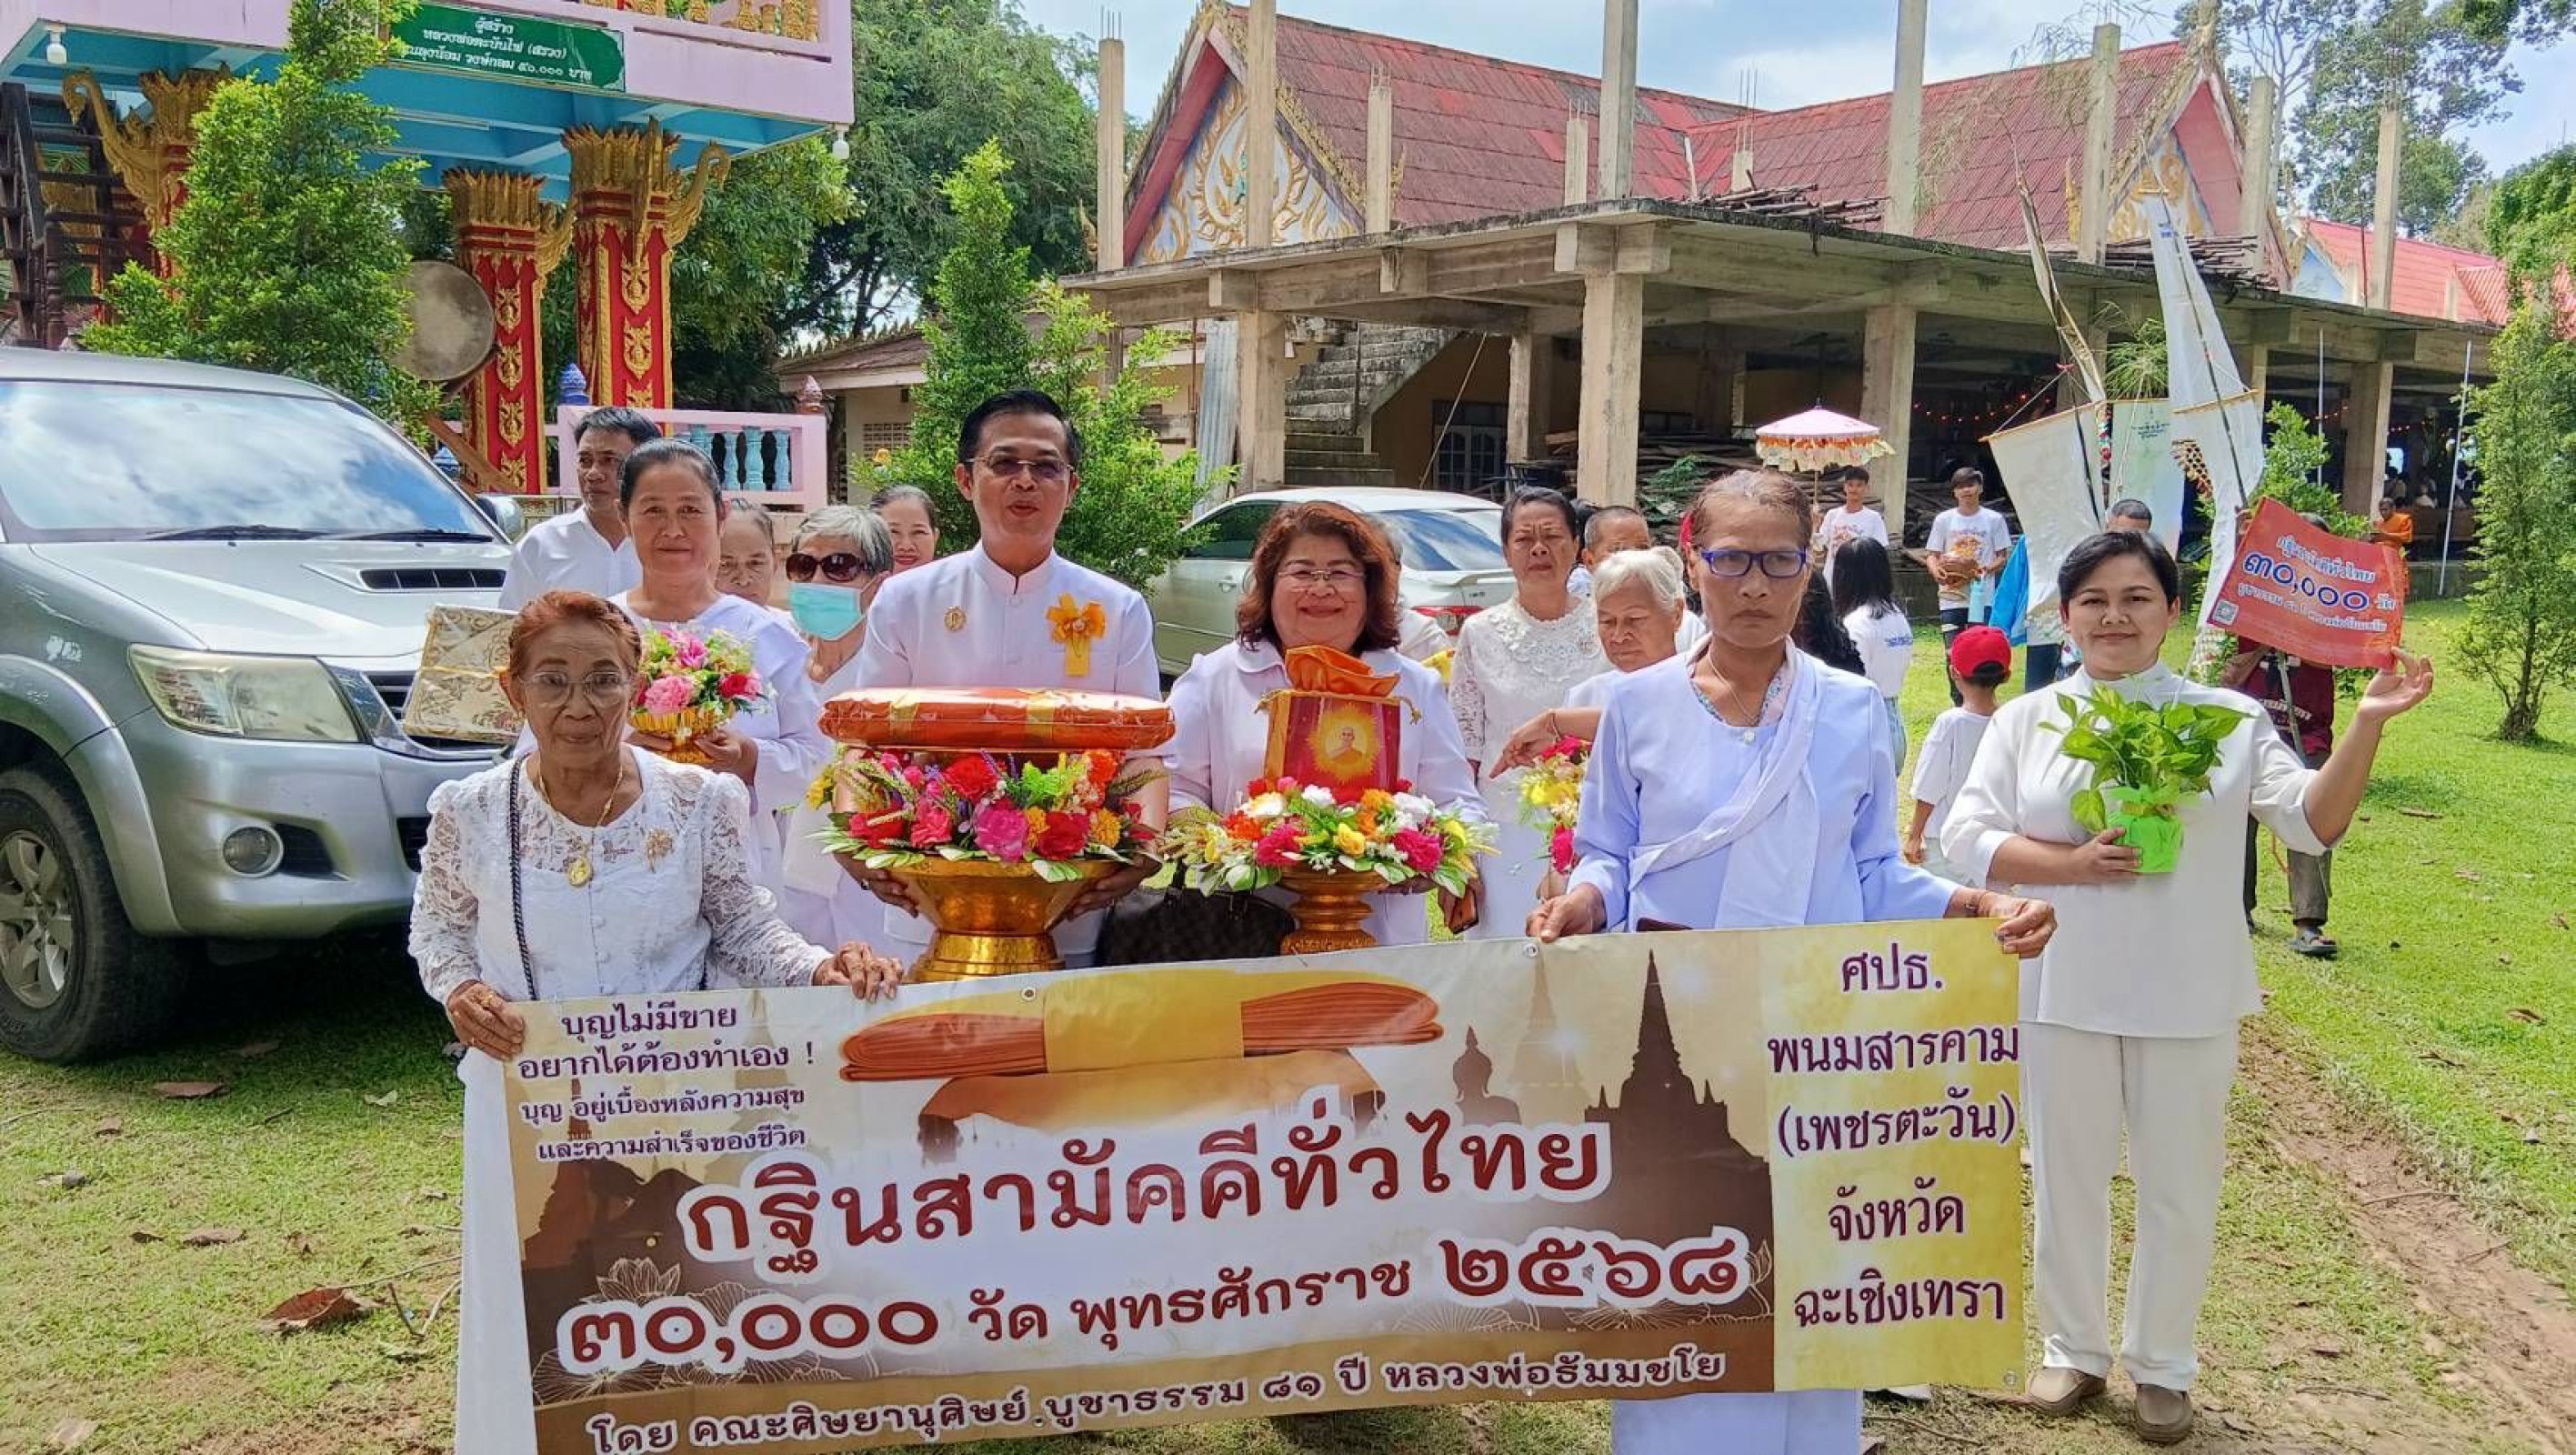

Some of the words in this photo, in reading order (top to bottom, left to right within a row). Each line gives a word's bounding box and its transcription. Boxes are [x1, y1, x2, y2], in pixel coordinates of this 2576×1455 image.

[2243, 552, 2369, 610] ๓๐,๐๐๐
[1842, 942, 1943, 992] ศปธ.
[562, 1002, 737, 1040] บุญไม่มีขาย
[1768, 1025, 2019, 1073] พนมสารคาม
[519, 1039, 789, 1079] อยากได้ต้องทำเอง
[806, 1041, 814, 1064] !
[522, 1101, 562, 1123] บุญ
[574, 1088, 805, 1123] อยู่เบื้องหลังความสุข
[1778, 1087, 2016, 1157] (เพชรตะวัน)
[538, 1126, 805, 1159] และความสำเร็จของชีวิต
[688, 1097, 1598, 1275] กฐินสามัคคีทั่วไทย
[1828, 1177, 1964, 1241] จังหวัด
[570, 1299, 940, 1363] ๓๐,๐๐๐
[968, 1288, 1048, 1340] วัด
[1070, 1259, 1411, 1352] พุทธศักราช
[1438, 1235, 1747, 1299] ๒๕๖๘
[1794, 1268, 2005, 1328] ฉะเชิงเทรา
[593, 1419, 673, 1454] โดย
[694, 1389, 1027, 1439] คณะศิษยานุศิษย์
[1045, 1380, 1246, 1429] บูชาธรรม
[1264, 1374, 1321, 1400] ๘๑
[1338, 1359, 1367, 1391] ปี
[1386, 1348, 1725, 1392] หลวงพ่อธัมมชโย
